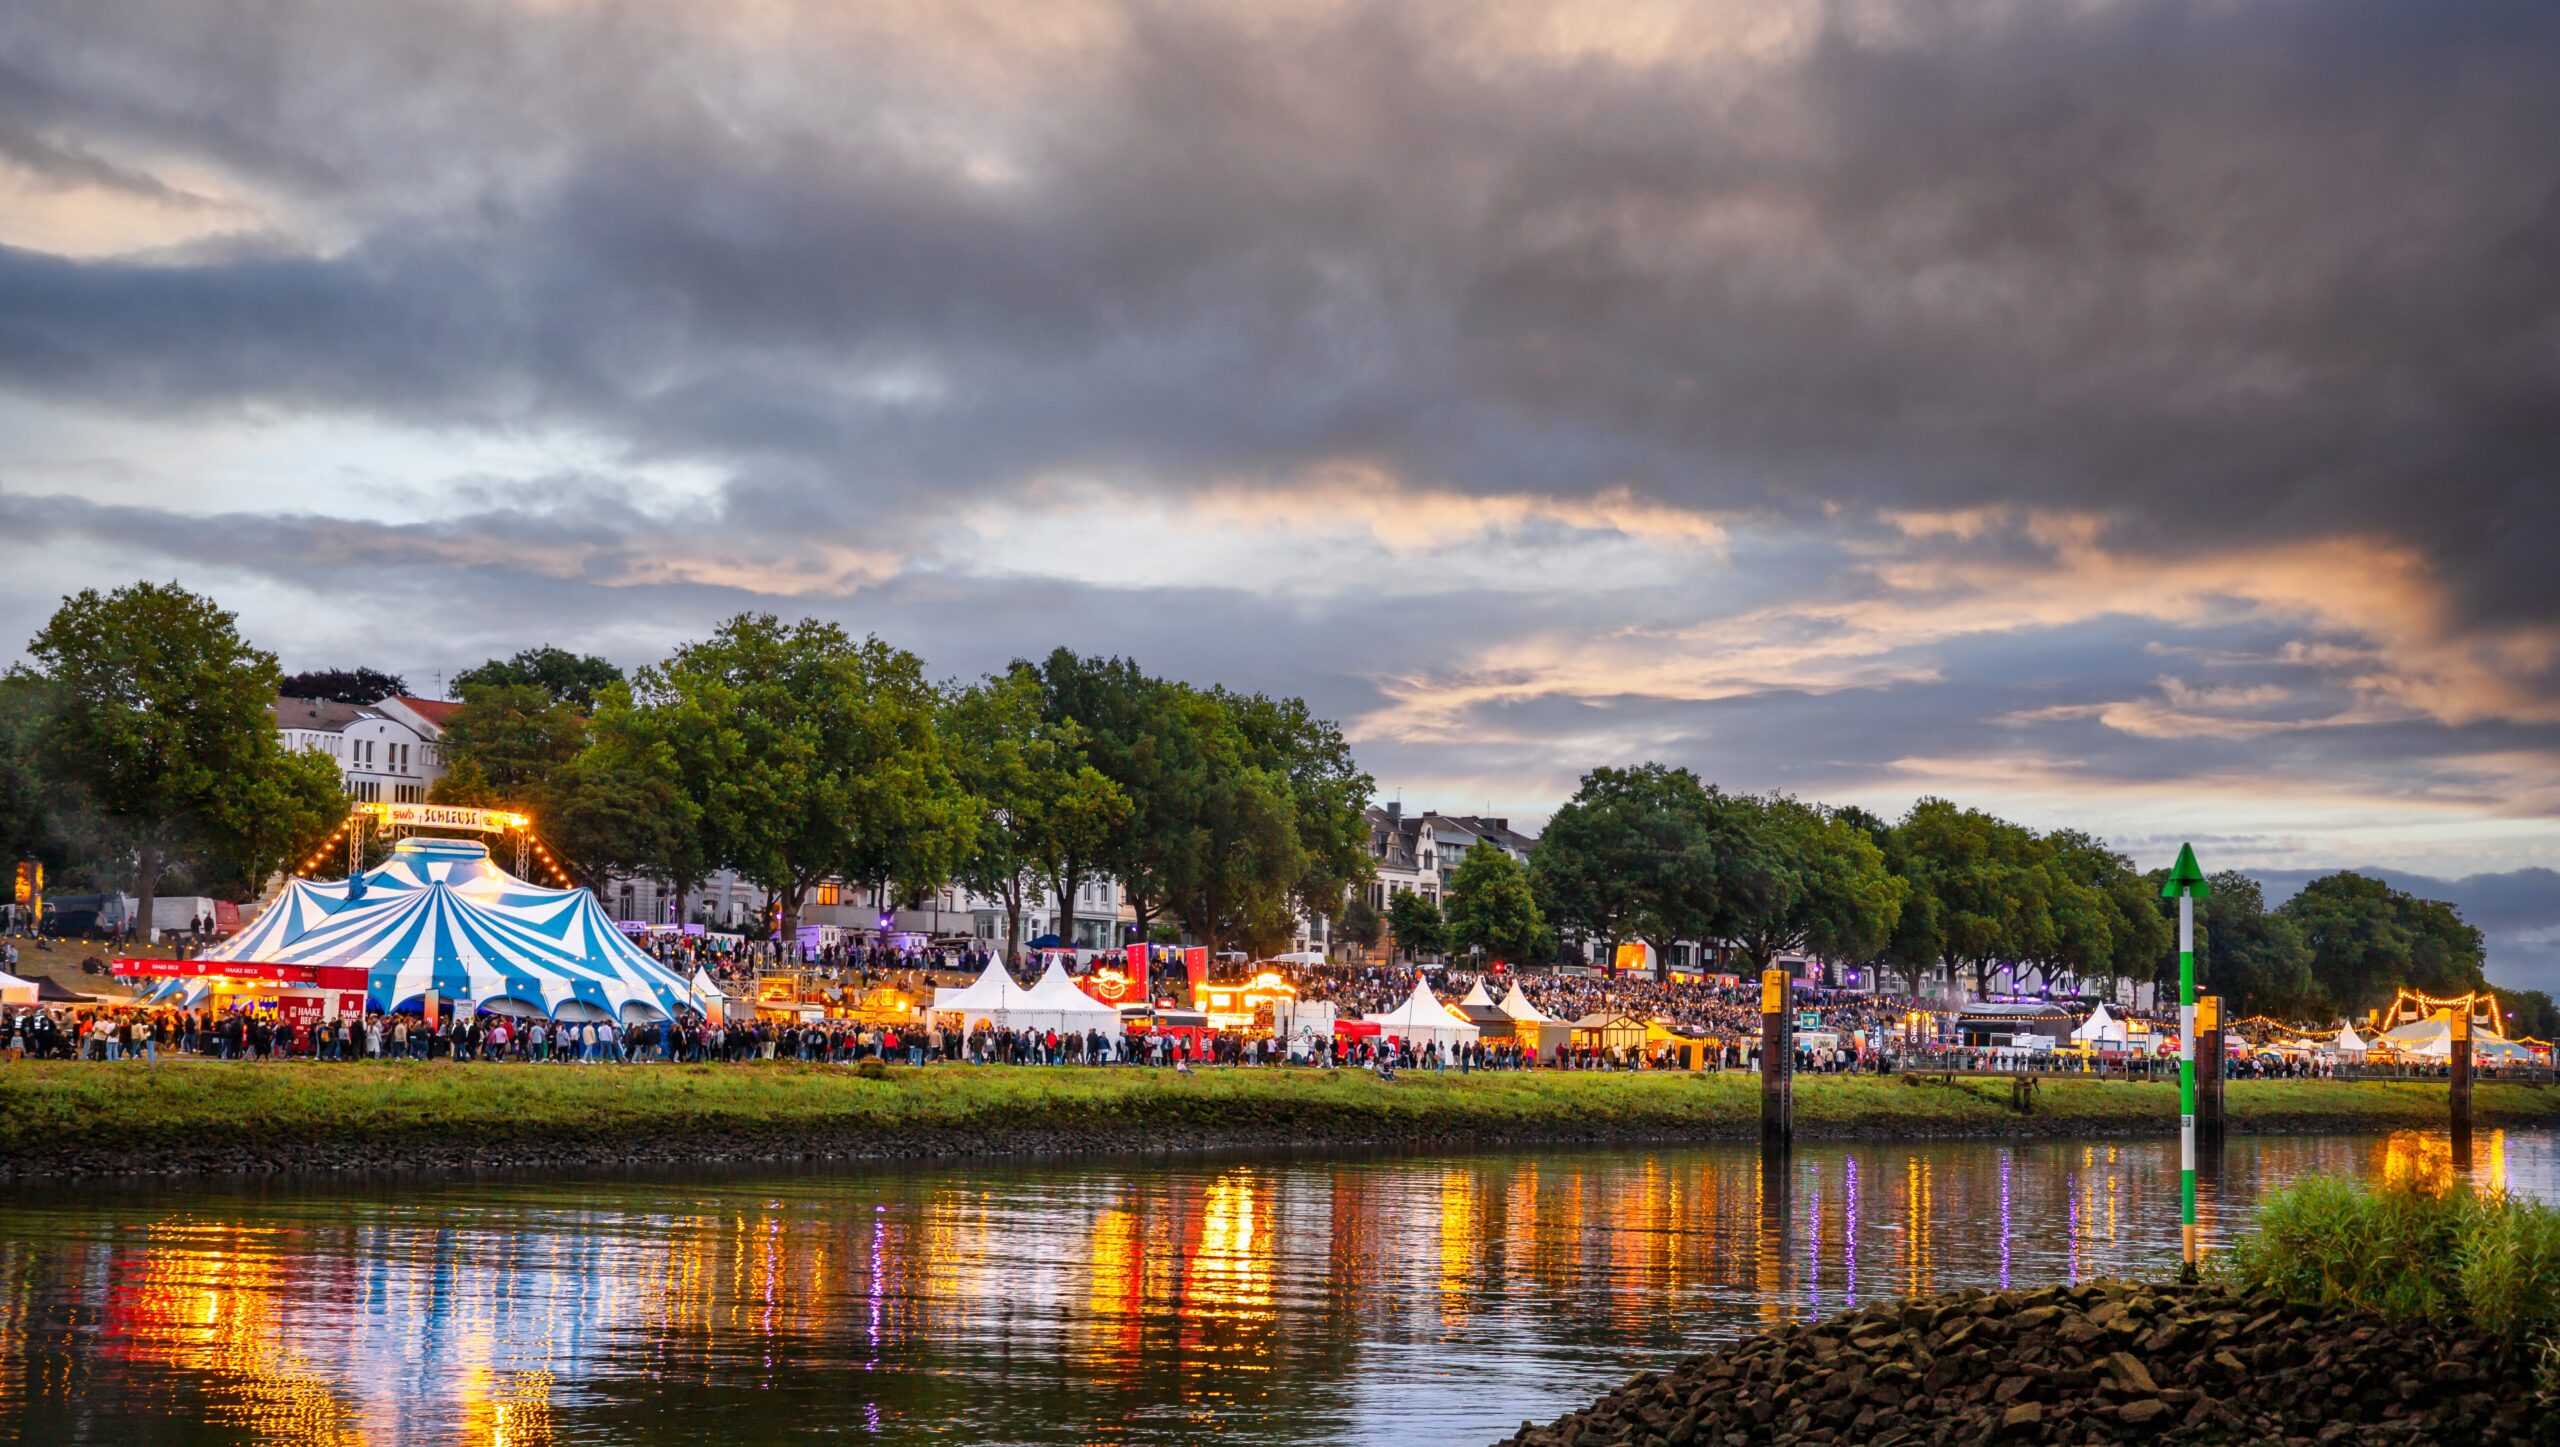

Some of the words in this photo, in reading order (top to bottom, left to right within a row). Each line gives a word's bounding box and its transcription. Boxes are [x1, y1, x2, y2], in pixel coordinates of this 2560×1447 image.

[393, 808, 415, 820] swb
[425, 808, 477, 825] SCHLEUSE
[298, 1007, 321, 1017] HAAKE
